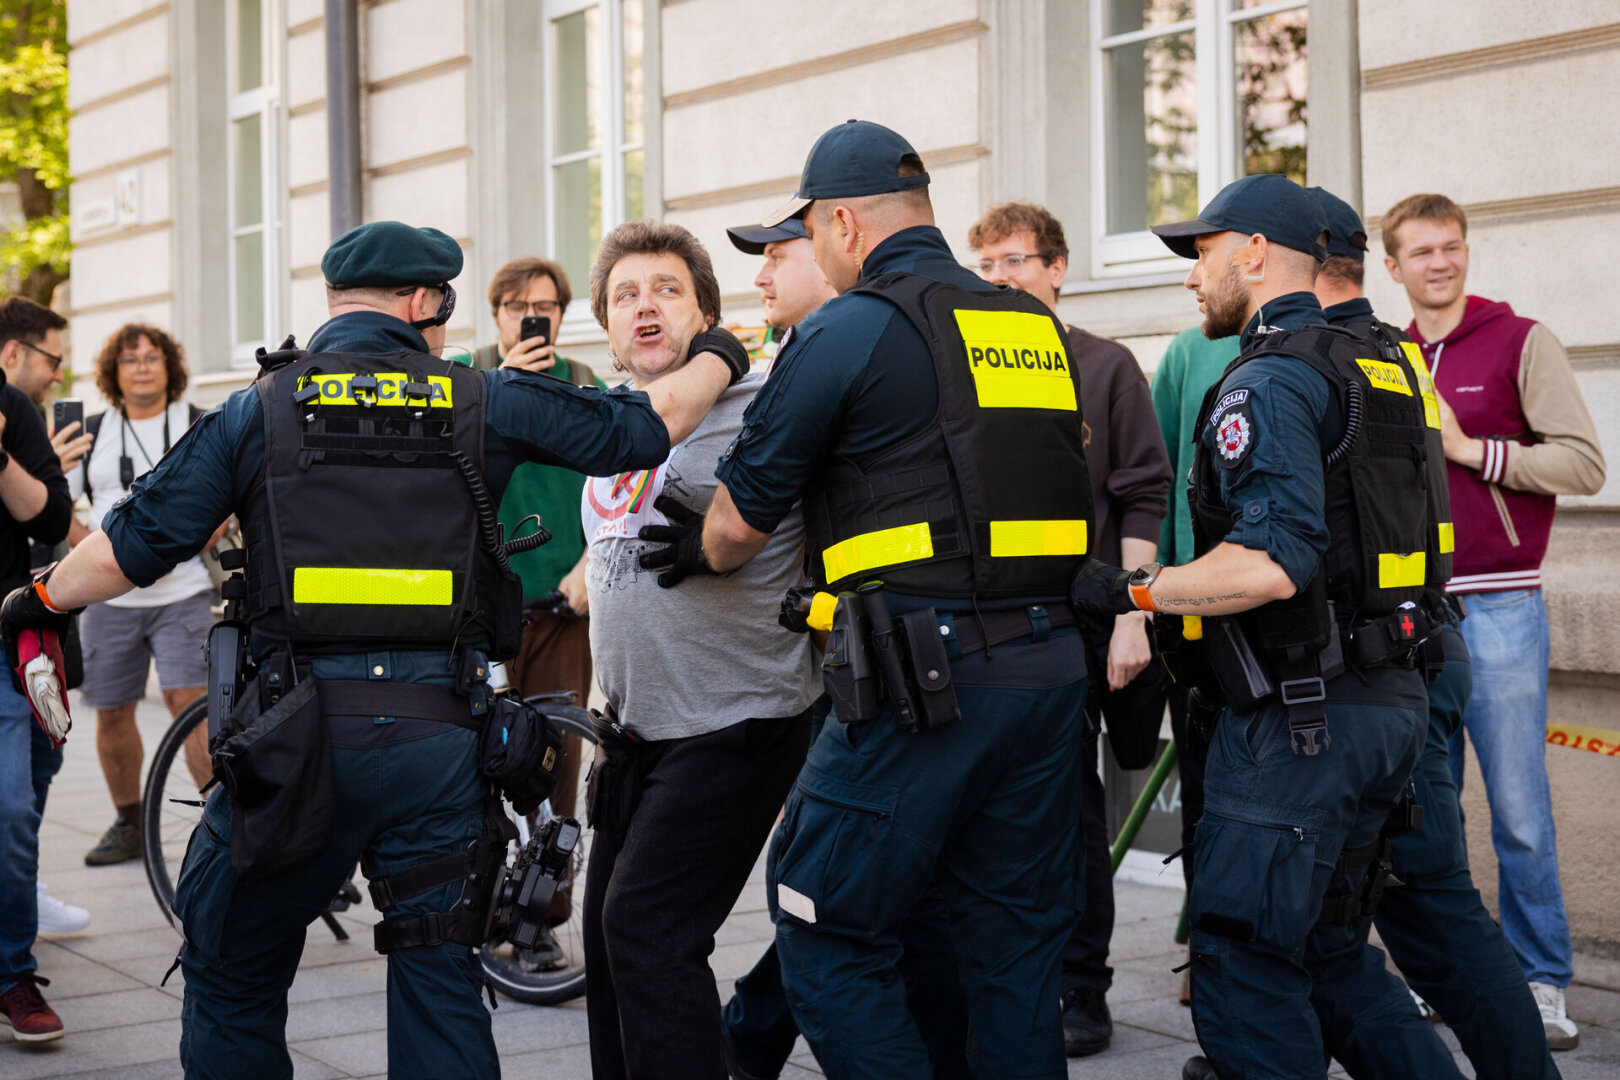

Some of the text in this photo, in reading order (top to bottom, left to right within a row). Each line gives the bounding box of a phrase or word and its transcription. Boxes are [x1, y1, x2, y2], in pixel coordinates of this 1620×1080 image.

[970, 346, 1067, 372] POLICIJA
[311, 379, 448, 402] OLCIA
[1212, 391, 1245, 422] POLICIJA
